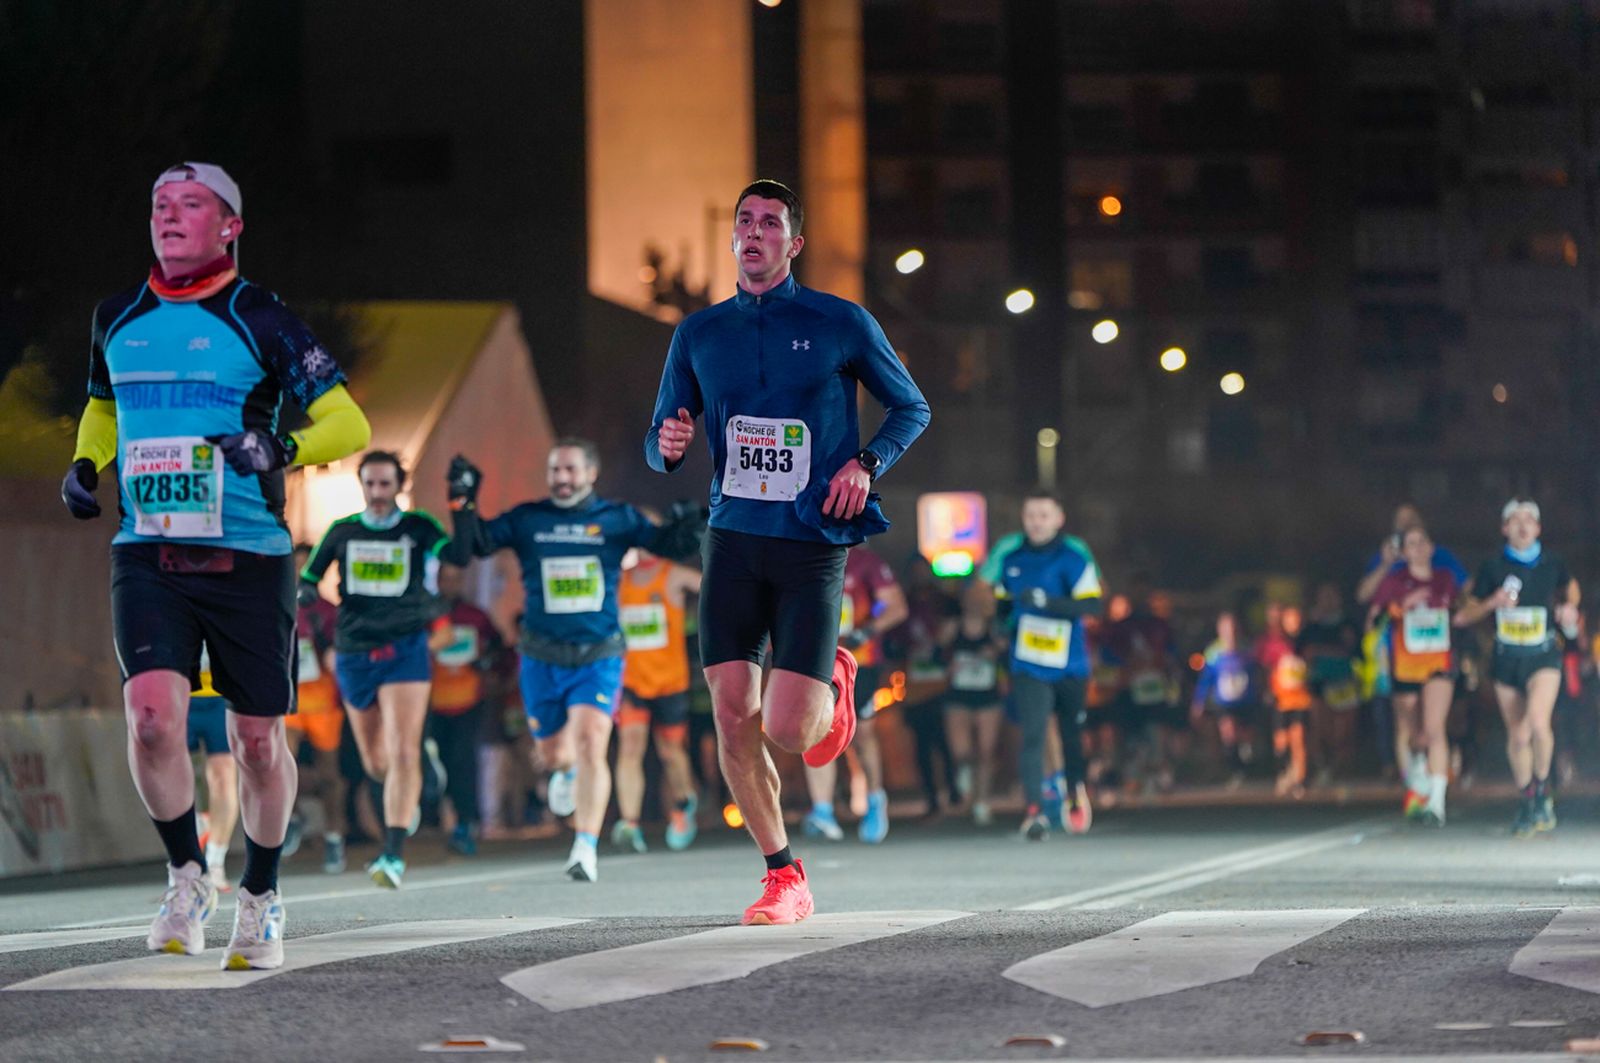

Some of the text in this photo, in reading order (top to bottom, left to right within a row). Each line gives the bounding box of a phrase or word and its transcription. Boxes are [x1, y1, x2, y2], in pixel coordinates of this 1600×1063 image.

[116, 384, 162, 409] EDIA
[736, 434, 749, 444] SAN
[749, 436, 776, 447] ANTÓN
[743, 426, 765, 436] NOCHE
[766, 427, 776, 437] DE
[140, 448, 182, 460] NOCHE DE
[740, 446, 793, 473] 5433
[132, 473, 209, 505] 12835
